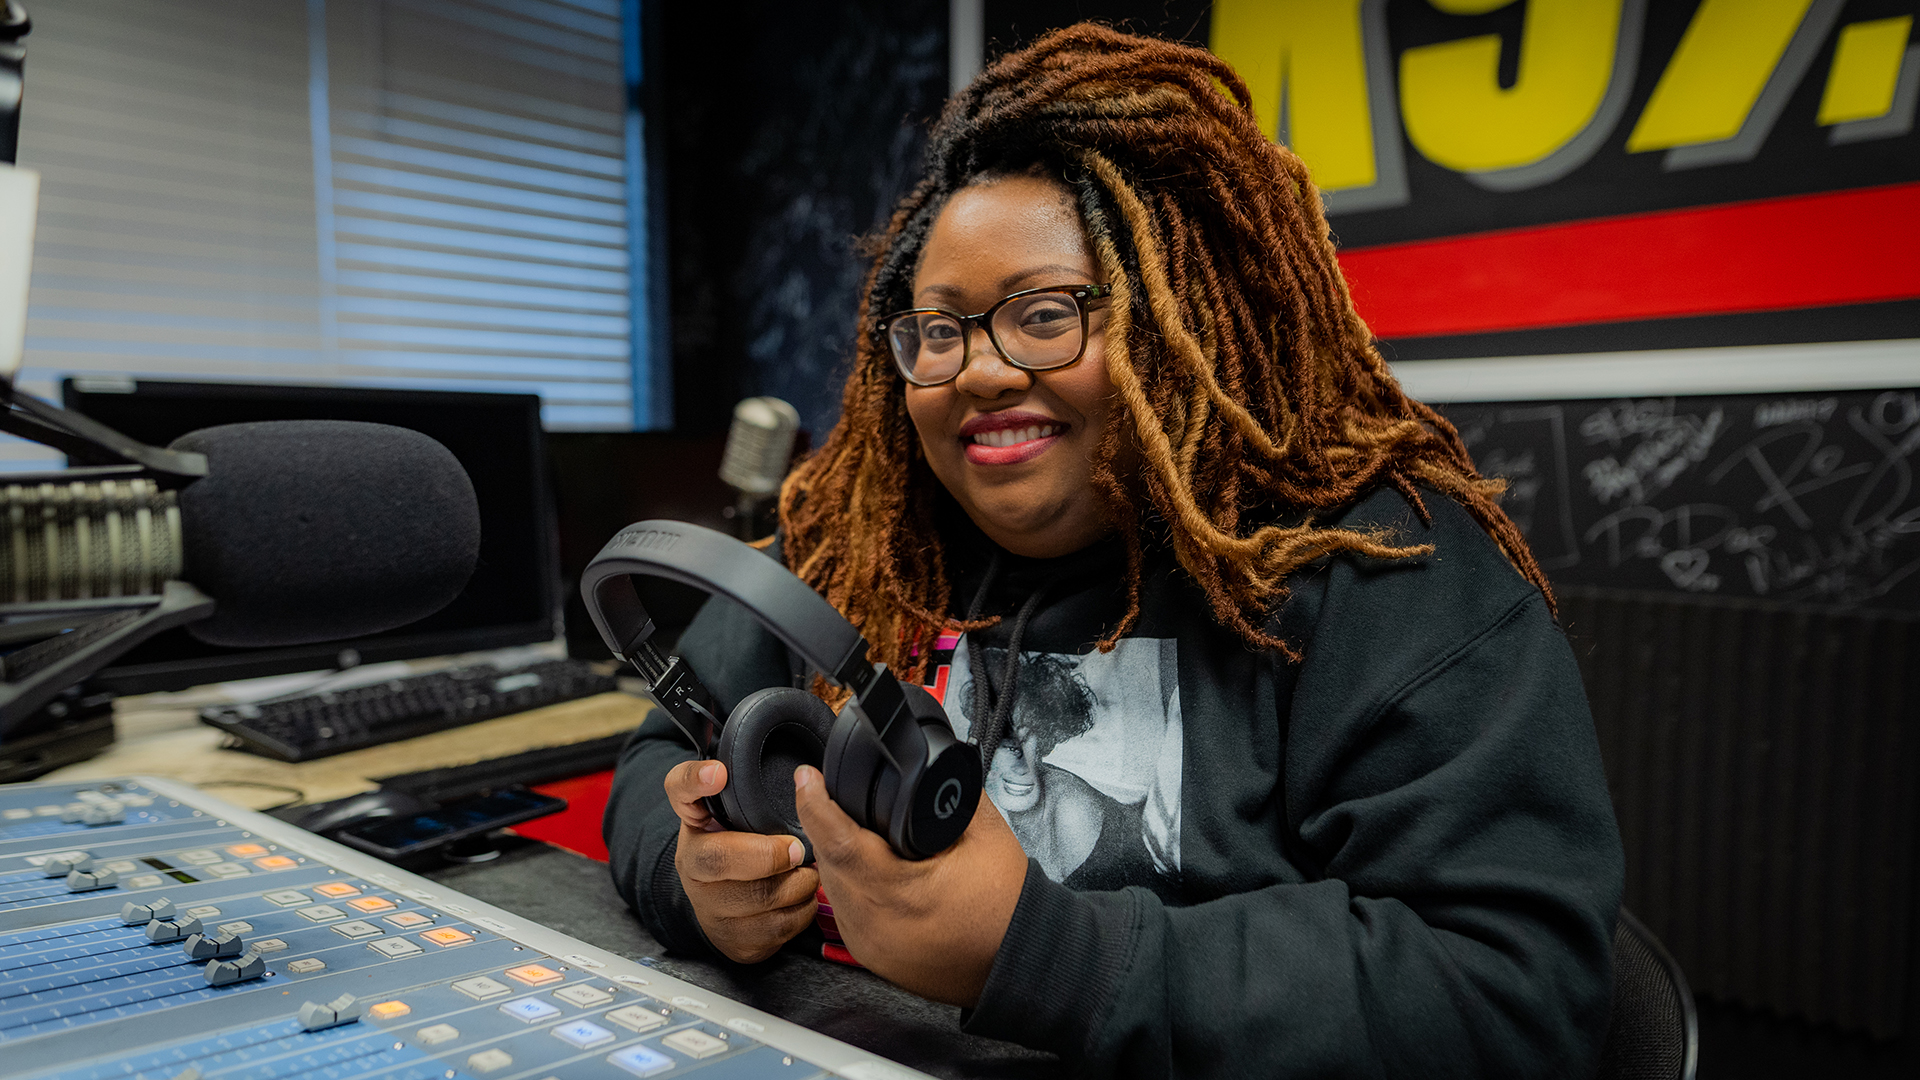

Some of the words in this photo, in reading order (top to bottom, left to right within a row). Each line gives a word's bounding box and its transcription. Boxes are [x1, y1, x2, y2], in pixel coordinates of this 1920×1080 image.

[675, 685, 685, 697] R
[389, 942, 404, 950] ON
[523, 969, 544, 978] OFF
[472, 981, 489, 990] ON
[523, 1003, 540, 1013] ON
